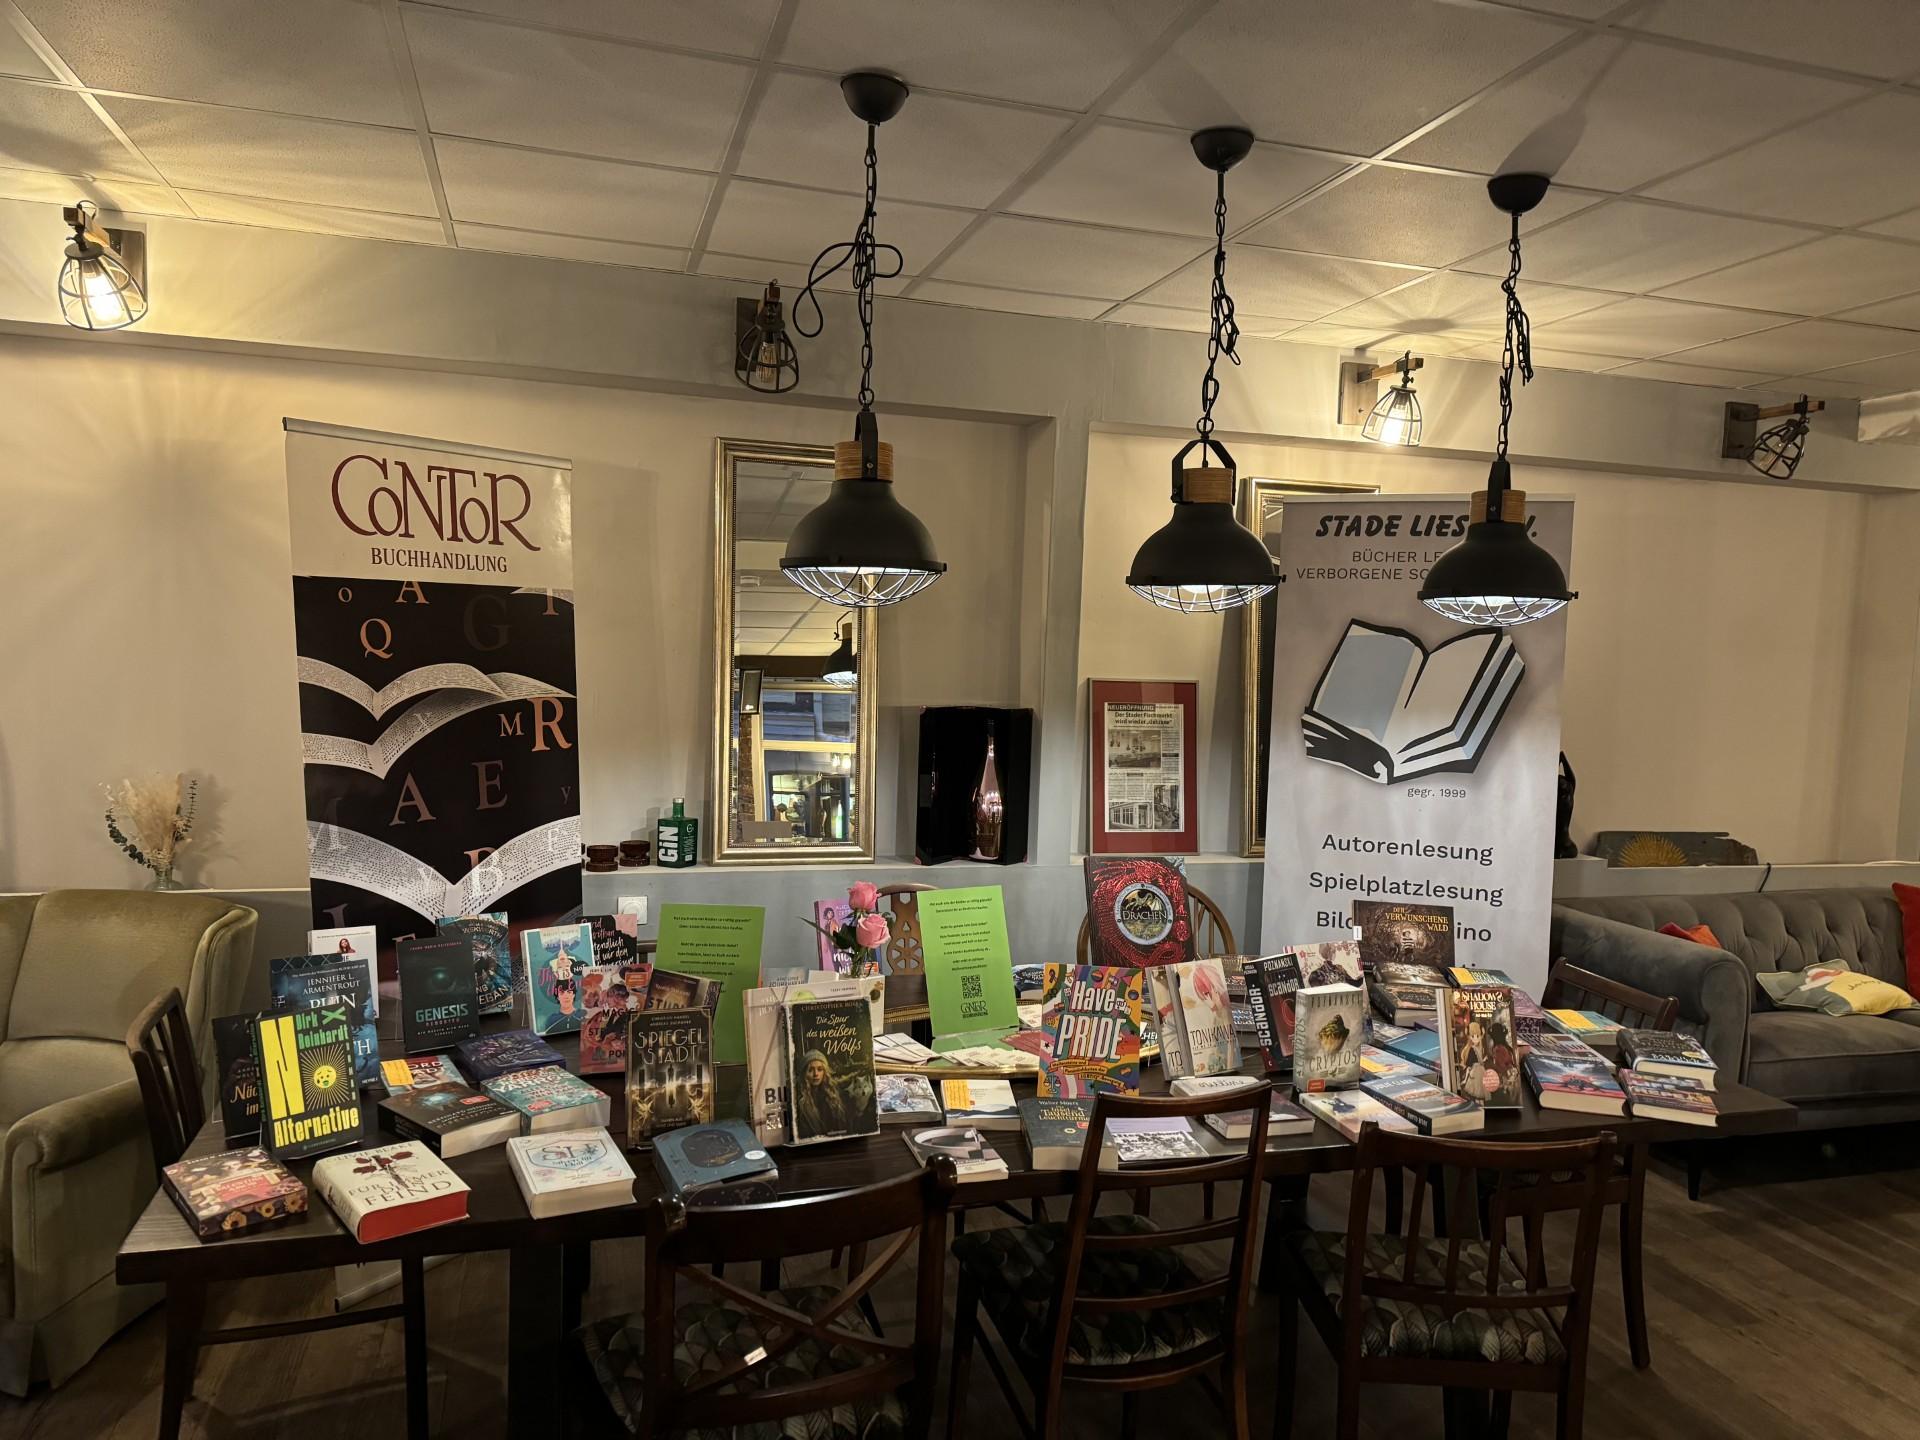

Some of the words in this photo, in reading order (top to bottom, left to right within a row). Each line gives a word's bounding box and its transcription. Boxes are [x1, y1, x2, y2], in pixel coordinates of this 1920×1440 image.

[1316, 515, 1402, 537] STADE
[371, 547, 507, 572] BUCHHANDLUNG
[1352, 549, 1417, 563] BÜCHER
[1296, 567, 1403, 580] VERBORGENE
[360, 618, 394, 659] Q
[499, 712, 524, 736] M
[527, 697, 573, 752] R
[472, 760, 508, 810] E
[1407, 786, 1436, 798] gegr.
[1439, 788, 1466, 798] 1999
[389, 772, 437, 826] A
[1322, 834, 1494, 867] Autorenlesung
[1309, 872, 1504, 907] Spielplatzlesung
[1122, 911, 1167, 920] DRACHEN
[1385, 913, 1448, 924] VERWUNSCHENE
[1427, 923, 1449, 932] WALD
[1263, 956, 1294, 971] POZNANSKI
[303, 980, 360, 995] ARMENTROUT
[308, 974, 347, 986] JENNIFER
[1071, 981, 1116, 1012] Have
[1461, 991, 1504, 1002] SHADOWS
[1470, 1001, 1497, 1011] HOUSE
[296, 1011, 318, 1031] Dirk
[416, 1004, 469, 1022] GENESIS
[828, 1014, 849, 1026] Spur
[298, 1024, 349, 1049] Reinhardt
[634, 1028, 706, 1049] SPIEGEL
[820, 1024, 857, 1038] weißen
[1056, 1015, 1126, 1059] PRIDE
[643, 1046, 697, 1064] STADT
[824, 1037, 861, 1055] Wolfs
[1309, 1050, 1357, 1073] CRYPTOS
[274, 1106, 359, 1148] Alternative
[365, 1180, 452, 1206] FEIND
